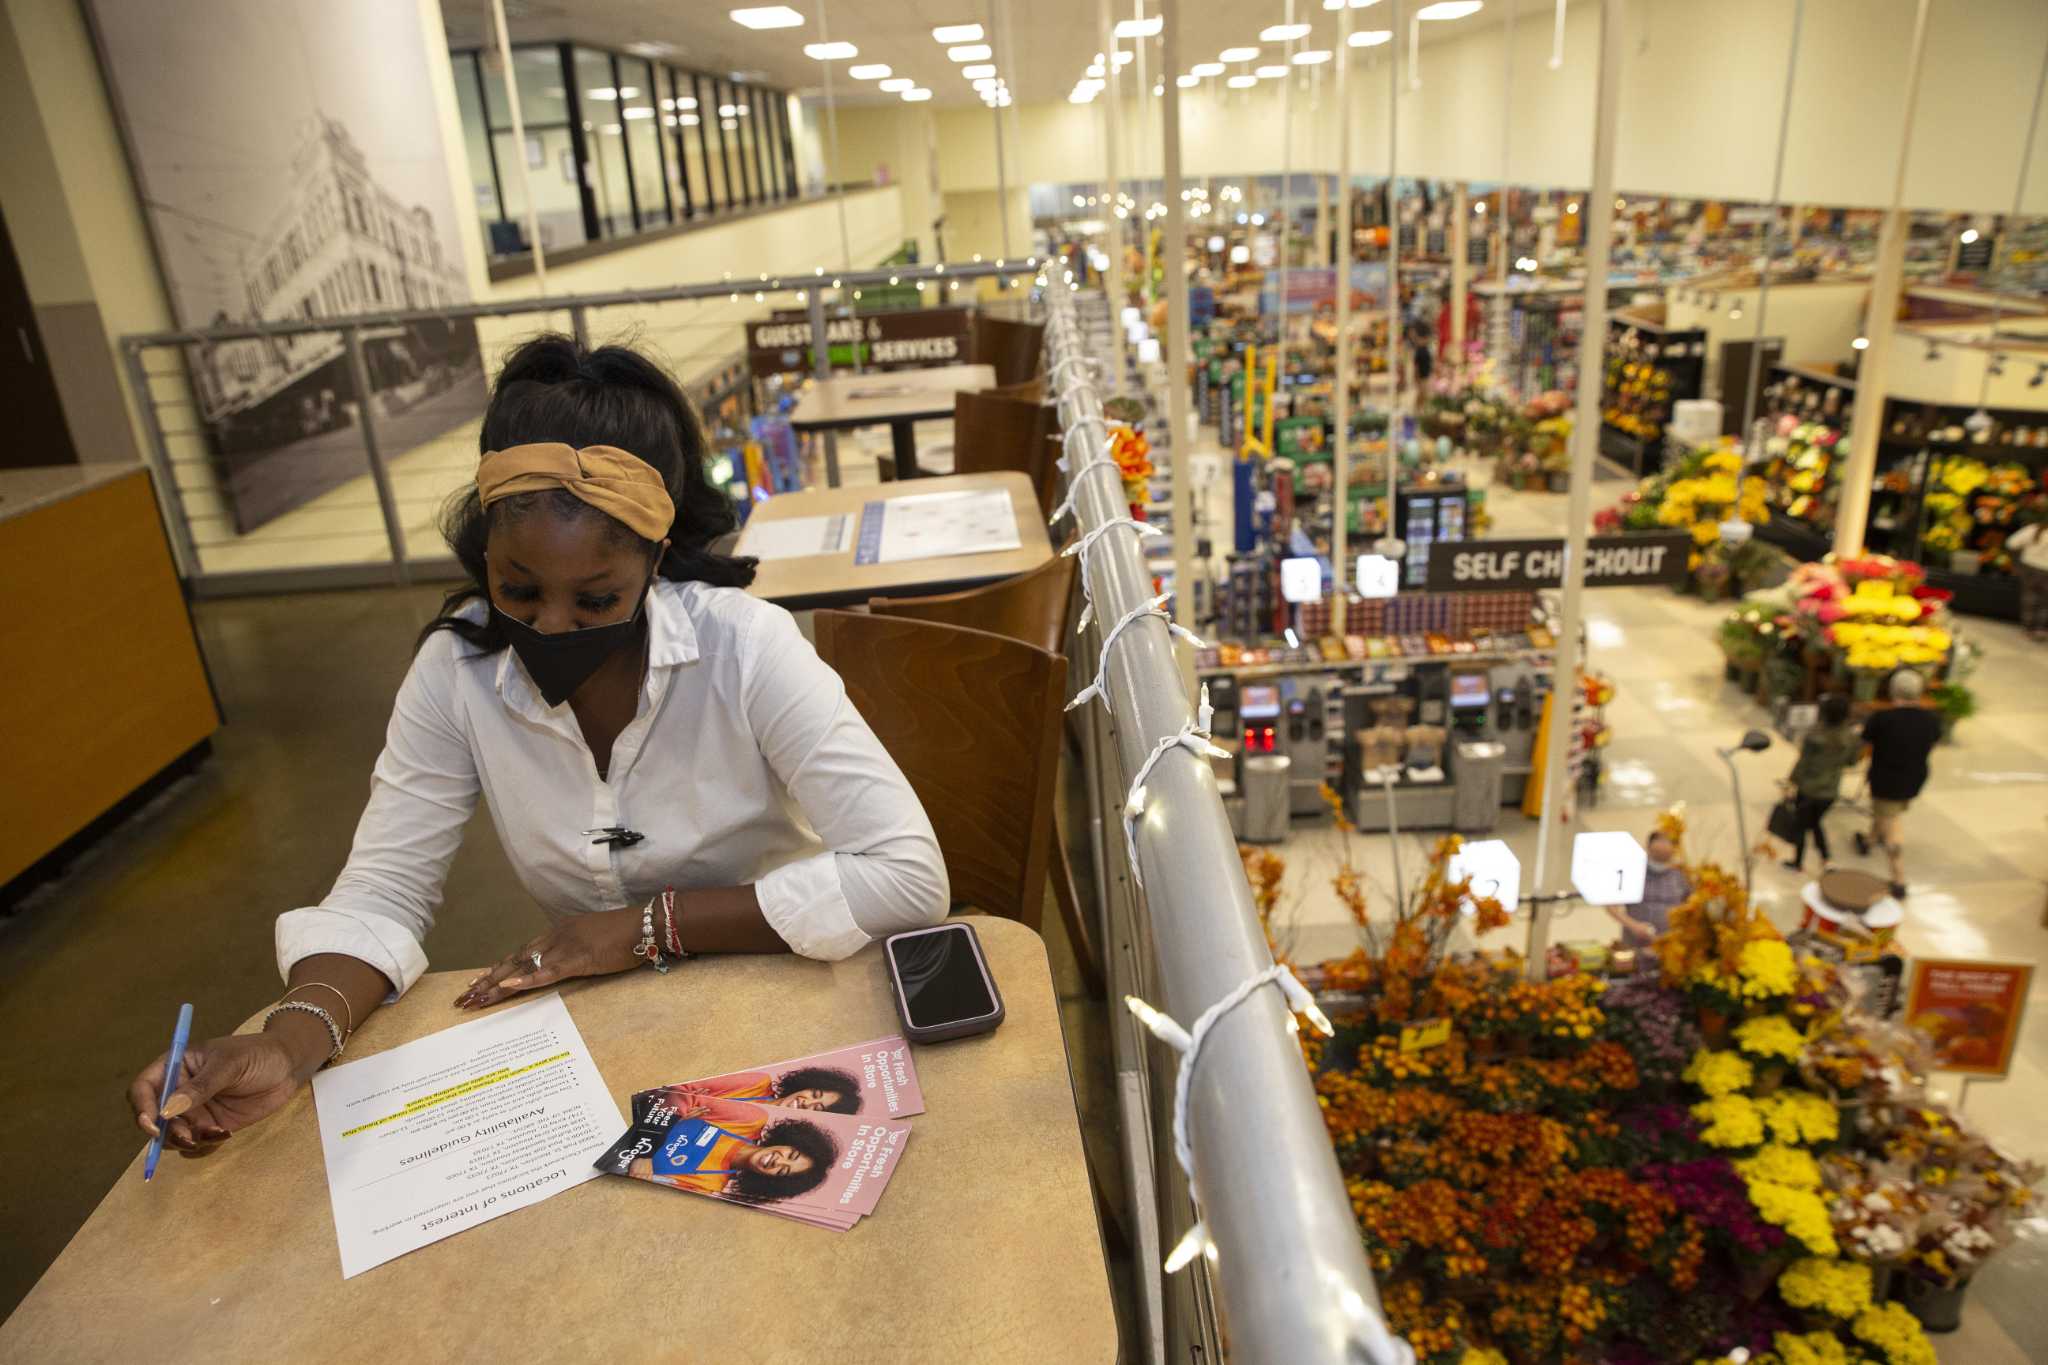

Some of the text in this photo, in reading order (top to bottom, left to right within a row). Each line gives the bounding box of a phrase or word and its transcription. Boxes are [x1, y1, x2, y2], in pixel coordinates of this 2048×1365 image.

[826, 319, 864, 342] ARE
[872, 337, 958, 362] SERVICES
[1452, 546, 1668, 580] SELF CHCKOUT
[1616, 869, 1624, 892] 1
[860, 1053, 877, 1088] In Store
[876, 1051, 899, 1113] Opportunities
[893, 1062, 909, 1086] Fresh
[644, 1098, 665, 1124] Future
[651, 1107, 668, 1125] Your
[660, 1106, 679, 1127] Feed
[398, 1105, 546, 1168] Availability Guidelines
[665, 1134, 689, 1158] Kroger
[841, 1124, 871, 1169] In Store
[617, 1137, 653, 1169] Kroger
[839, 1126, 887, 1204] Opportunities
[870, 1146, 893, 1178] Fresh
[419, 1167, 566, 1233] Locations of Interest
